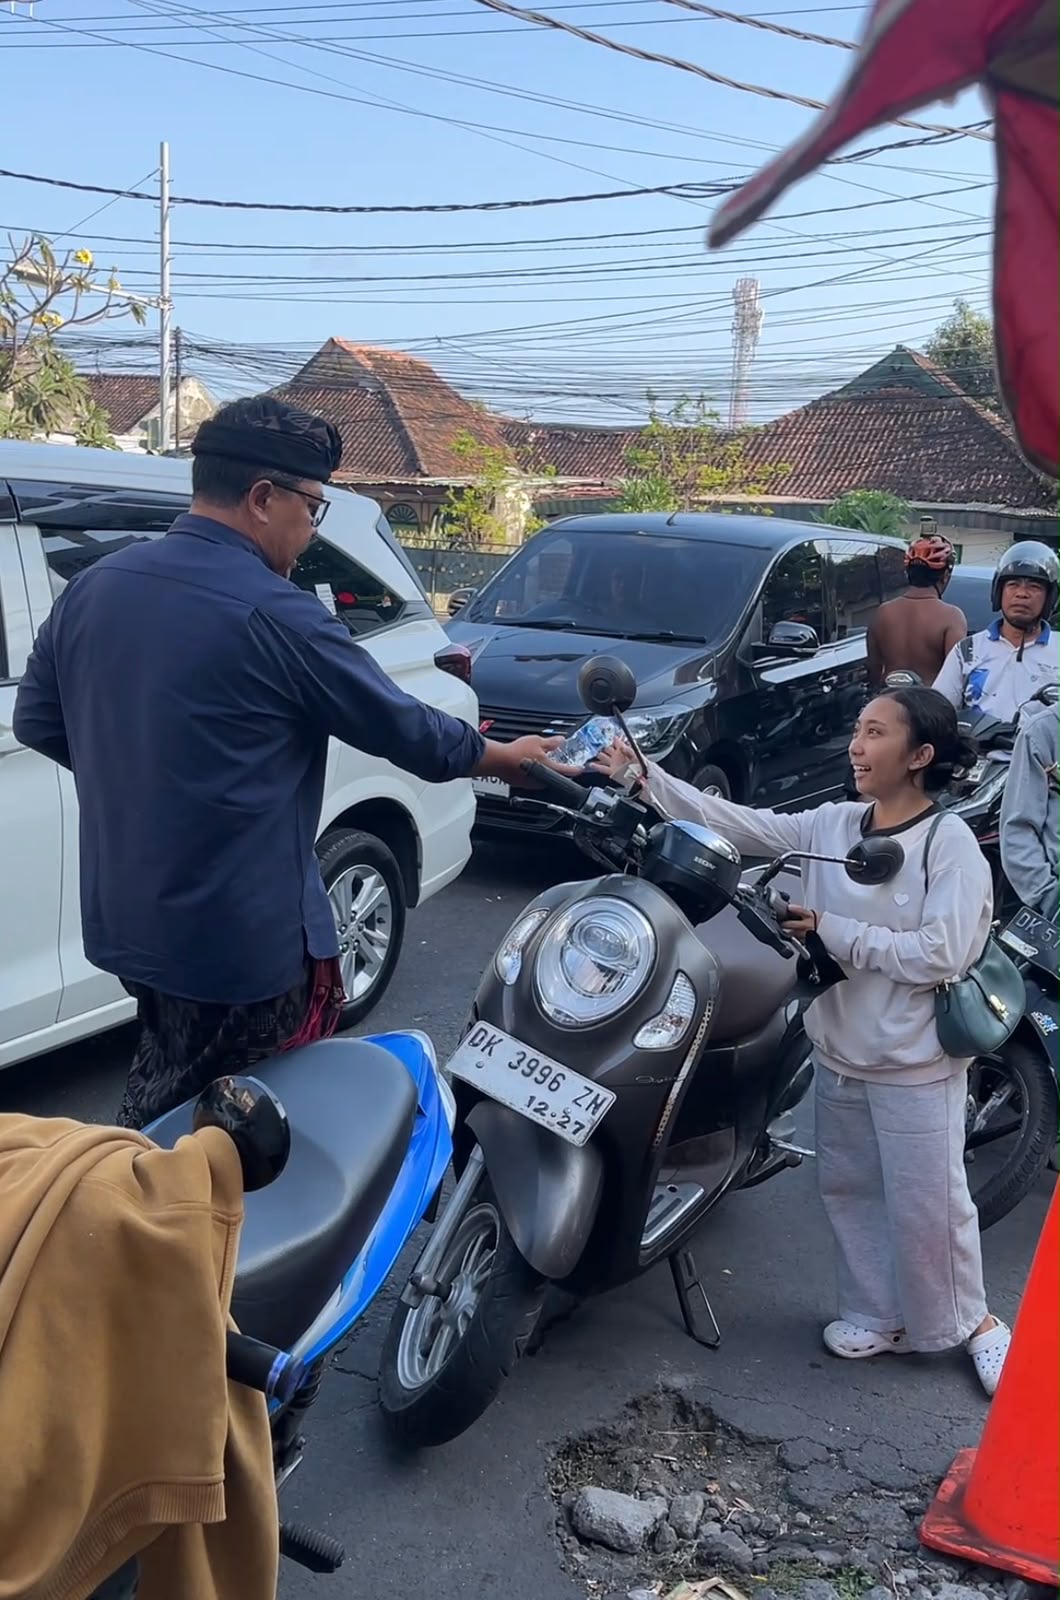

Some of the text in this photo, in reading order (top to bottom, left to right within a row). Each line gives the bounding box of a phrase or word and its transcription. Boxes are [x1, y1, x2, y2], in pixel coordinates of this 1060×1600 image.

[1015, 912, 1043, 935] DK
[467, 1027, 608, 1117] DK 3996 ZN
